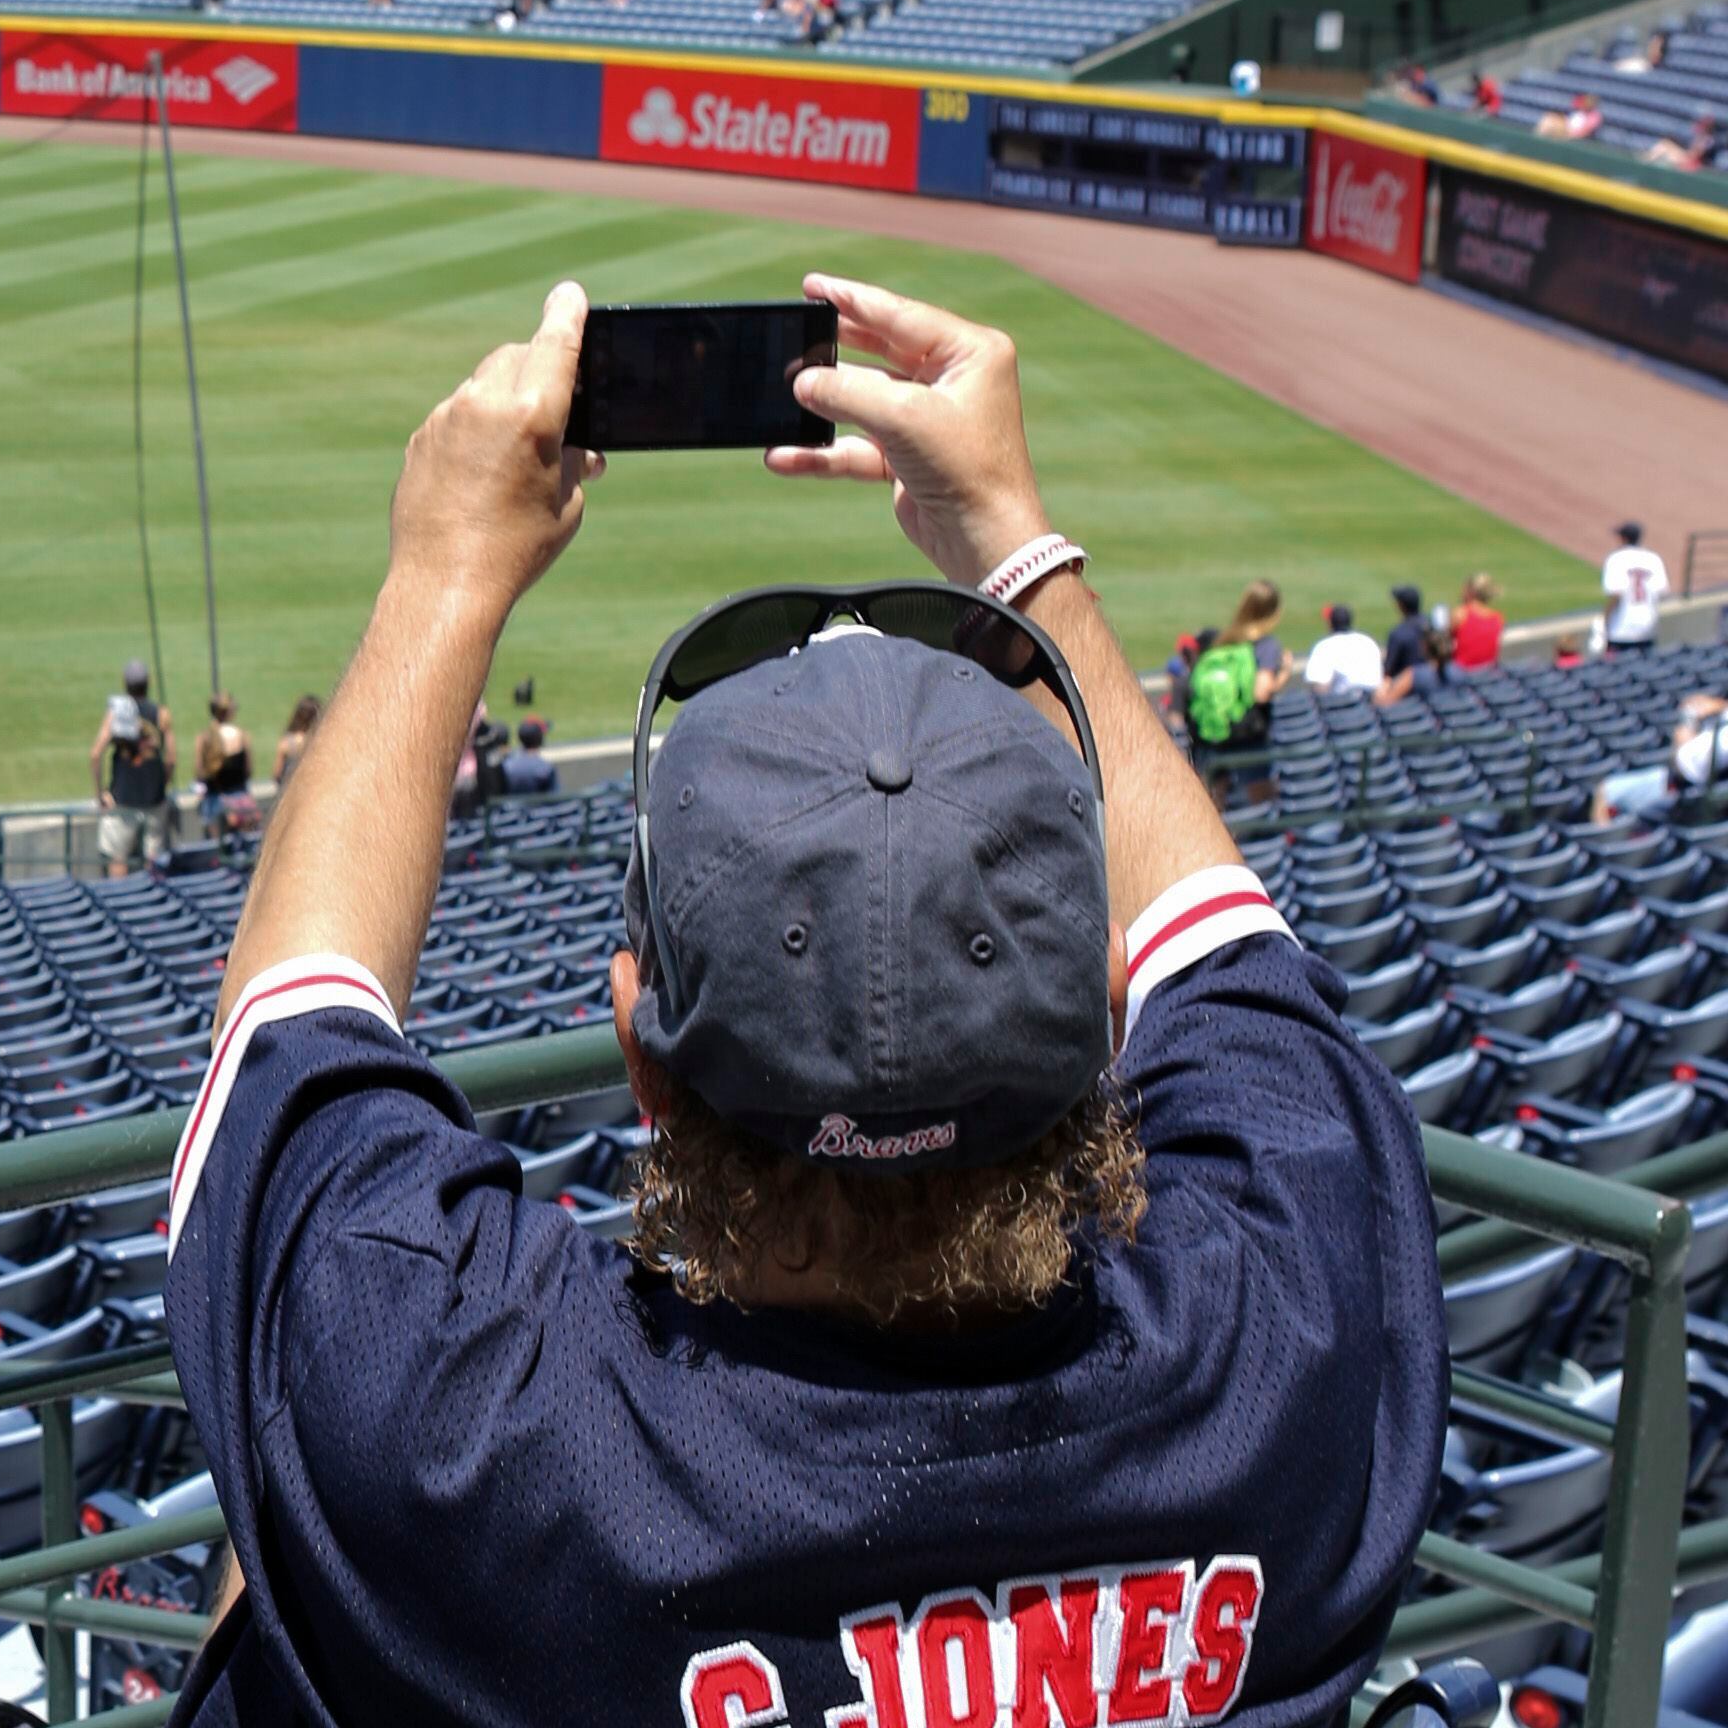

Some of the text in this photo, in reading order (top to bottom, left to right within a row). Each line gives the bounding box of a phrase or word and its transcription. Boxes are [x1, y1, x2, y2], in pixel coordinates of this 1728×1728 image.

[15, 58, 80, 95] Bank
[81, 63, 108, 97] of
[809, 1113, 956, 1160] Braves
